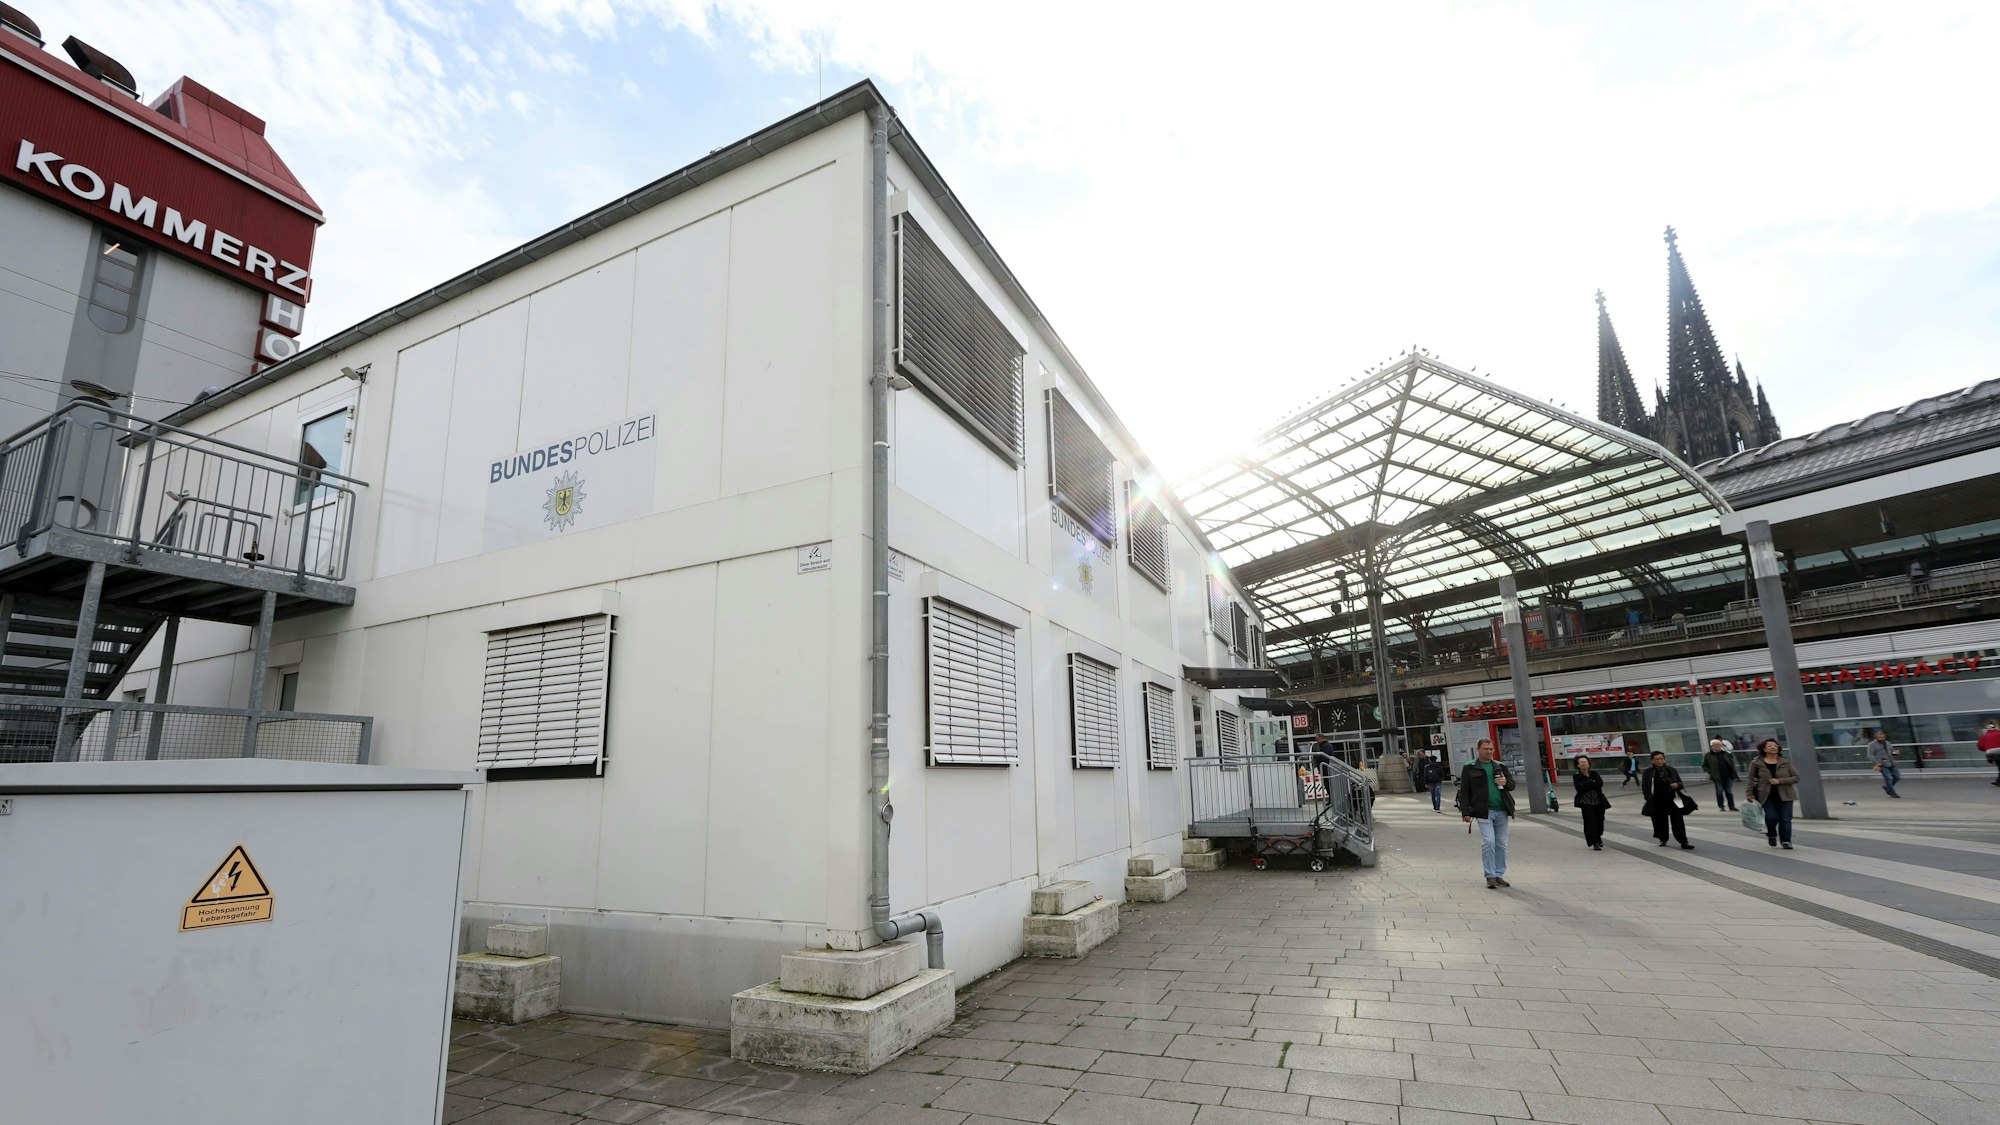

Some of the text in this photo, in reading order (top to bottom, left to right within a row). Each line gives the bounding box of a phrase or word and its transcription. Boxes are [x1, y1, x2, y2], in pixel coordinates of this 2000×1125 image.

[16, 139, 309, 296] KOMMERZ
[263, 296, 300, 368] HO
[490, 414, 656, 484] BUNDESPOLIZEI
[1466, 697, 1558, 718] APOTKE
[1799, 655, 1983, 686] PHARMACY
[1294, 716, 1307, 727] DB
[198, 904, 260, 916] Hochspannung
[200, 910, 257, 923] Lebensgefahr
